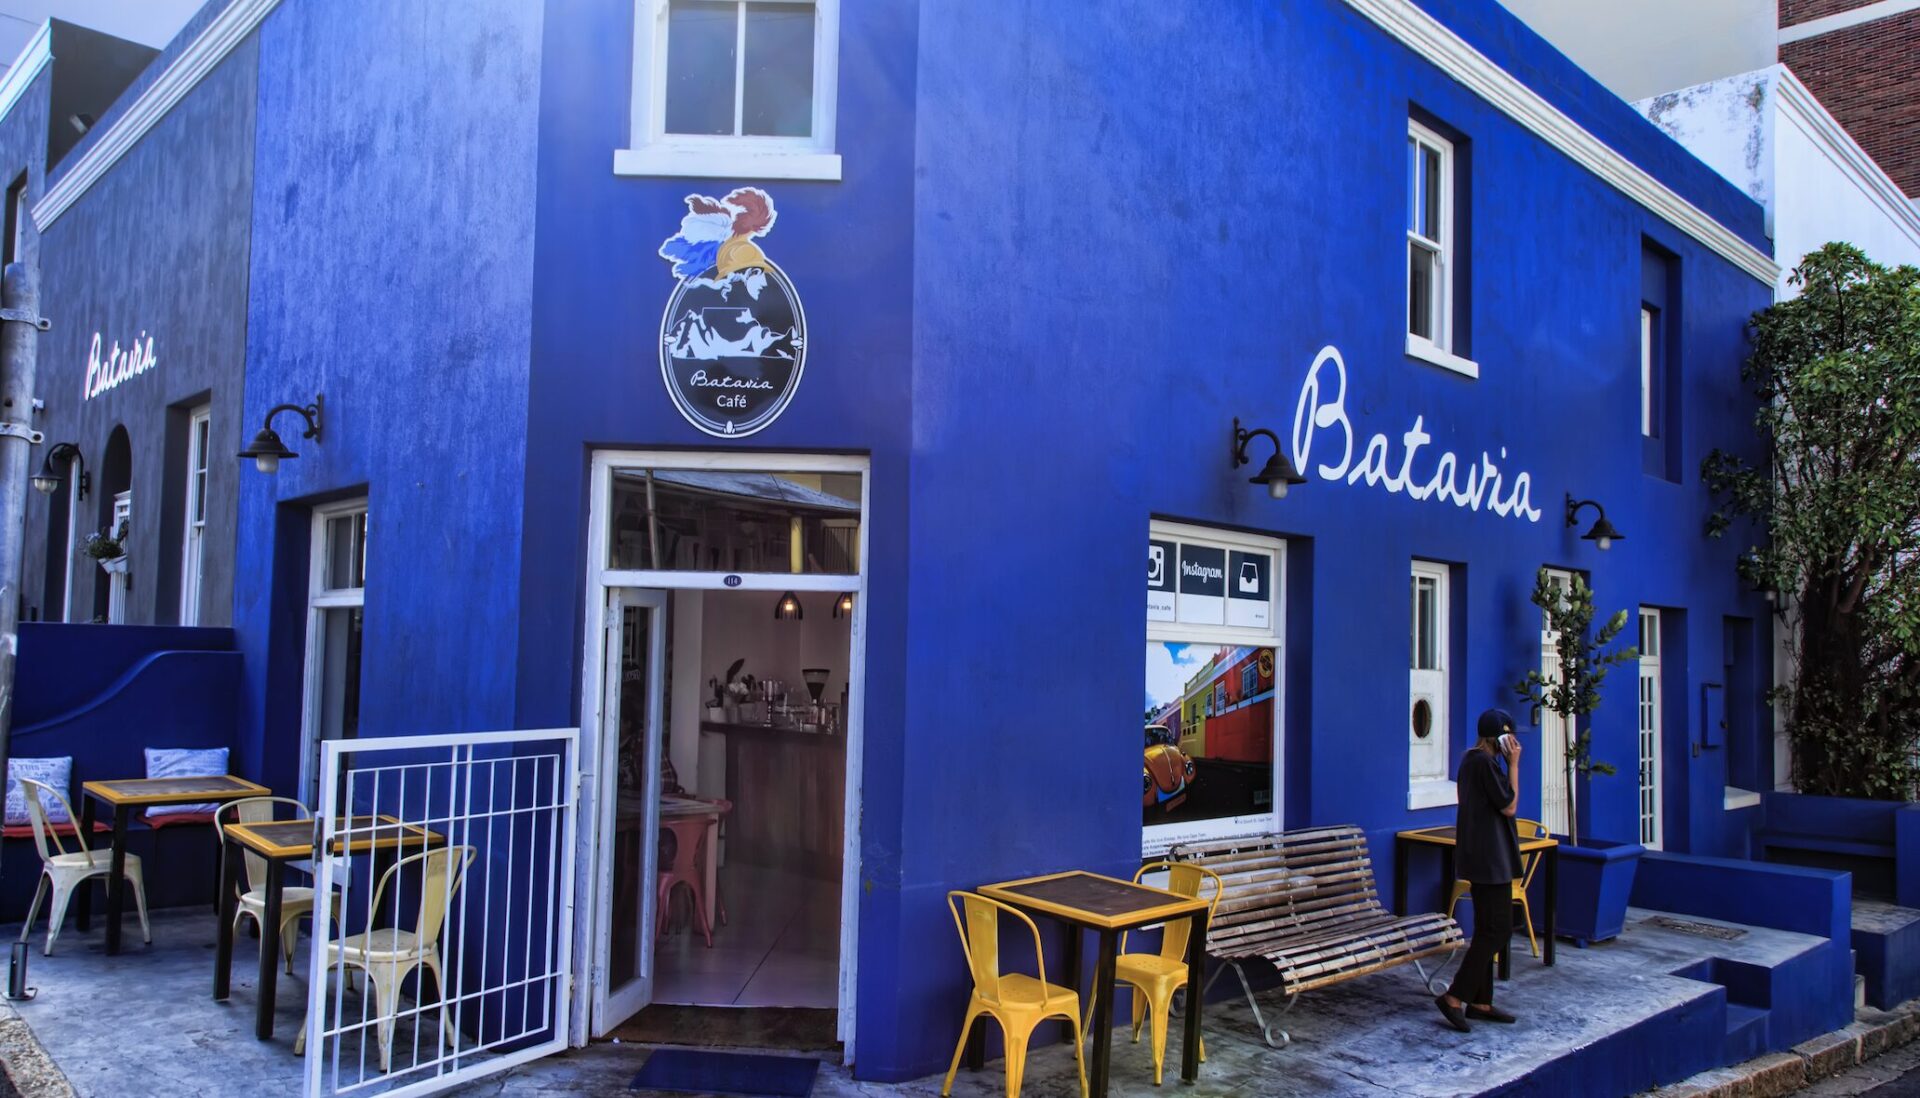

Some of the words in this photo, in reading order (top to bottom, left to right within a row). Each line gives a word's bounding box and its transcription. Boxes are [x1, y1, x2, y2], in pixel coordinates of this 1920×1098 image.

[84, 329, 157, 401] Batavia
[690, 369, 774, 389] Batavia
[716, 394, 747, 408] Café
[1292, 345, 1541, 522] Batavia
[1181, 560, 1223, 583] Instagram
